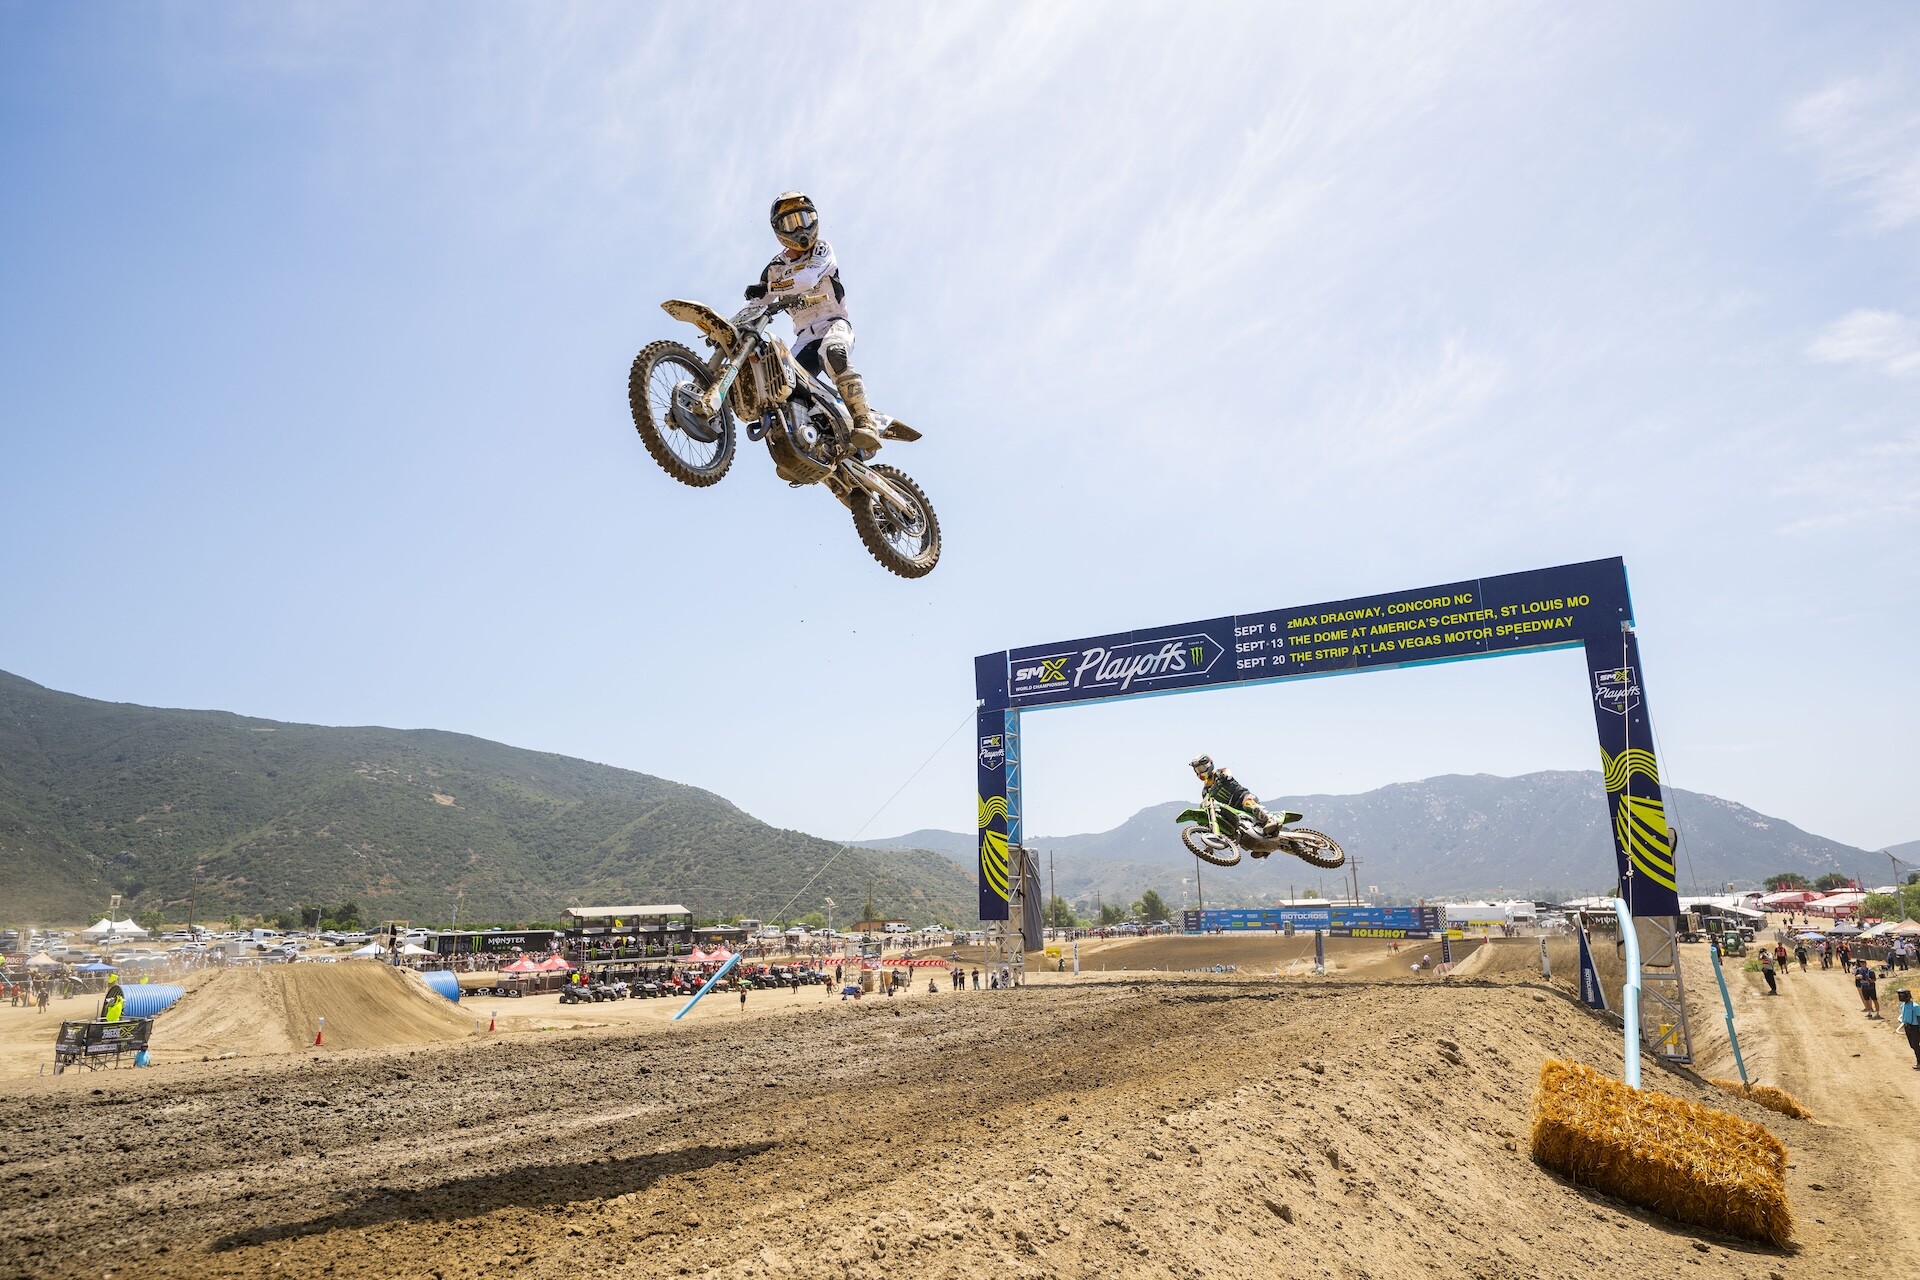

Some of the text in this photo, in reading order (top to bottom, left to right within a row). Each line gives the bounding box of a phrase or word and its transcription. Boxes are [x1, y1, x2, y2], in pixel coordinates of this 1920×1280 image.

[1234, 593, 1473, 637] SEPT 6 zMAX DRAGWAY, CONCORD NC
[1235, 595, 1590, 653] SEPT 13 THE DOME AT AMERICA'S CENTER, ST LOUIS MO
[1236, 616, 1574, 670] SEPT 20 THE STRIP AT LAS VEGAS MOTOR SPEEDWAY
[1015, 641, 1187, 691] SMX Playoffs
[1600, 670, 1629, 682] SMX
[1033, 681, 1069, 690] CHAMPIONSHIP
[1595, 685, 1640, 701] Playoffs
[1352, 928, 1406, 939] HOLESHOT
